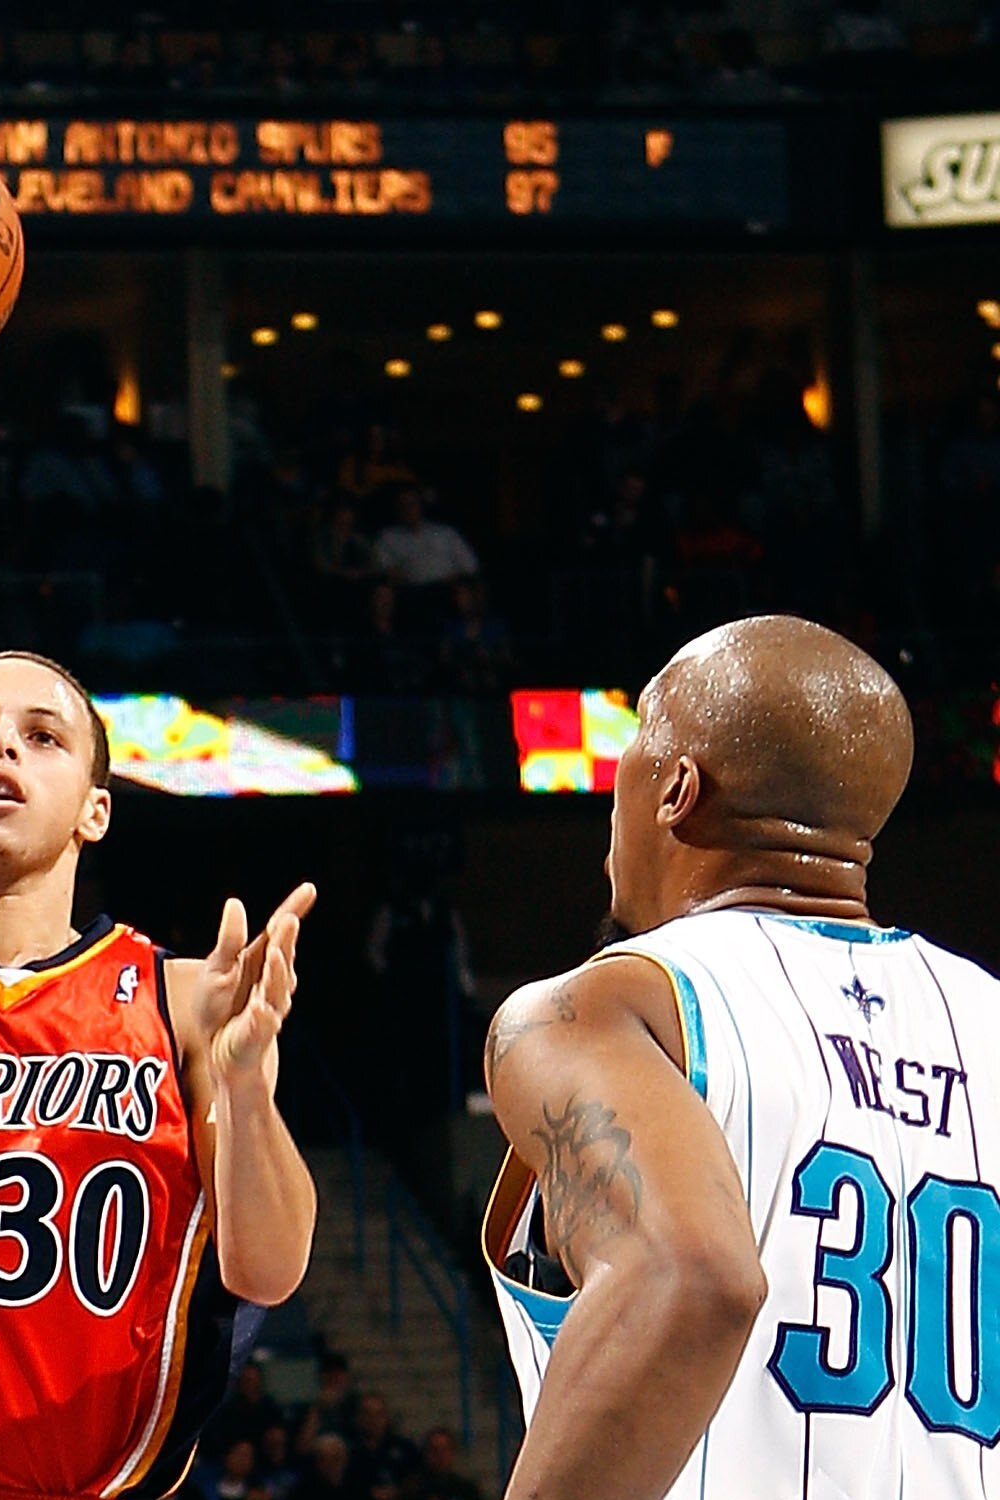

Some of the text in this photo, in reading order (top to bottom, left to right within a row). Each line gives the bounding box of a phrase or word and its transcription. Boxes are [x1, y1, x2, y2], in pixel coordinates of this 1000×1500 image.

[63, 119, 239, 165] ANTONIO
[256, 119, 382, 165] SPURS
[825, 1034, 967, 1138] WEST
[767, 1139, 1000, 1449] 30
